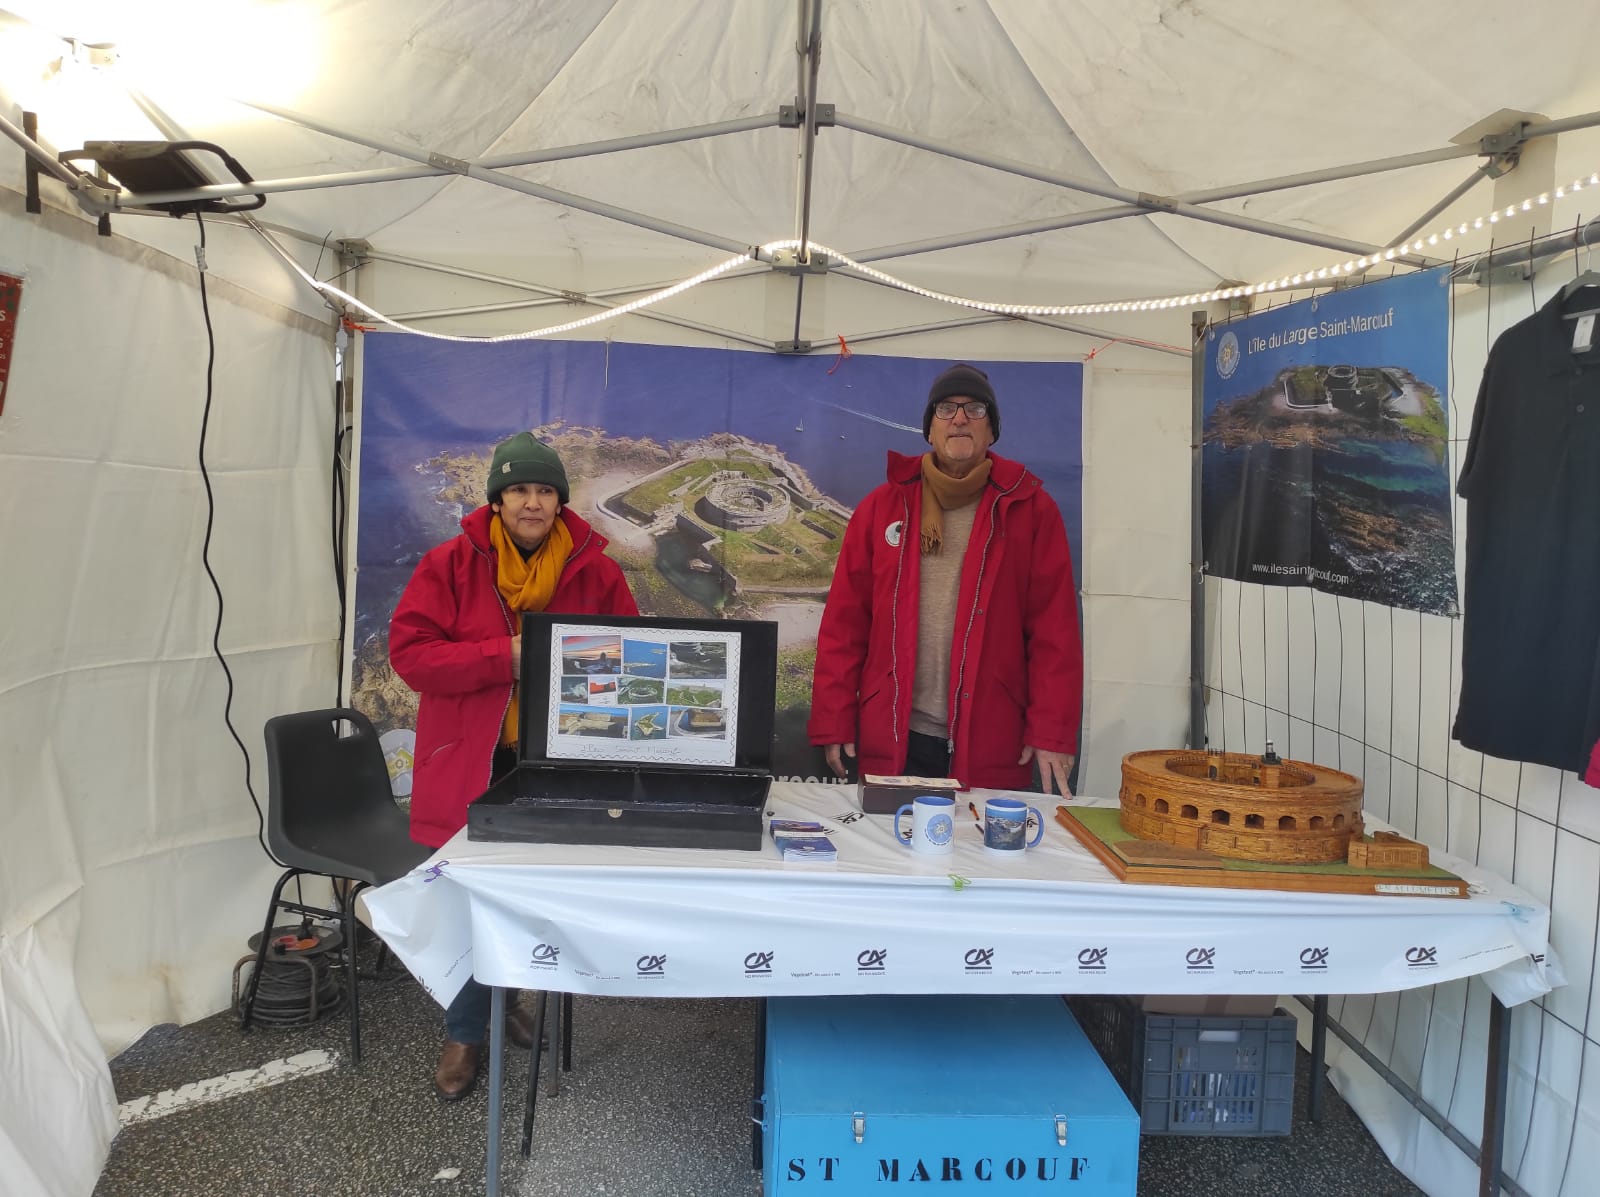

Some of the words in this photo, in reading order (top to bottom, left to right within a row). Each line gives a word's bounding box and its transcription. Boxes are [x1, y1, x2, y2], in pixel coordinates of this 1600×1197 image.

[1269, 332, 1281, 349] du
[1284, 327, 1318, 345] Large
[787, 1157, 839, 1182] ST
[876, 1157, 1091, 1183] MARCOUF
